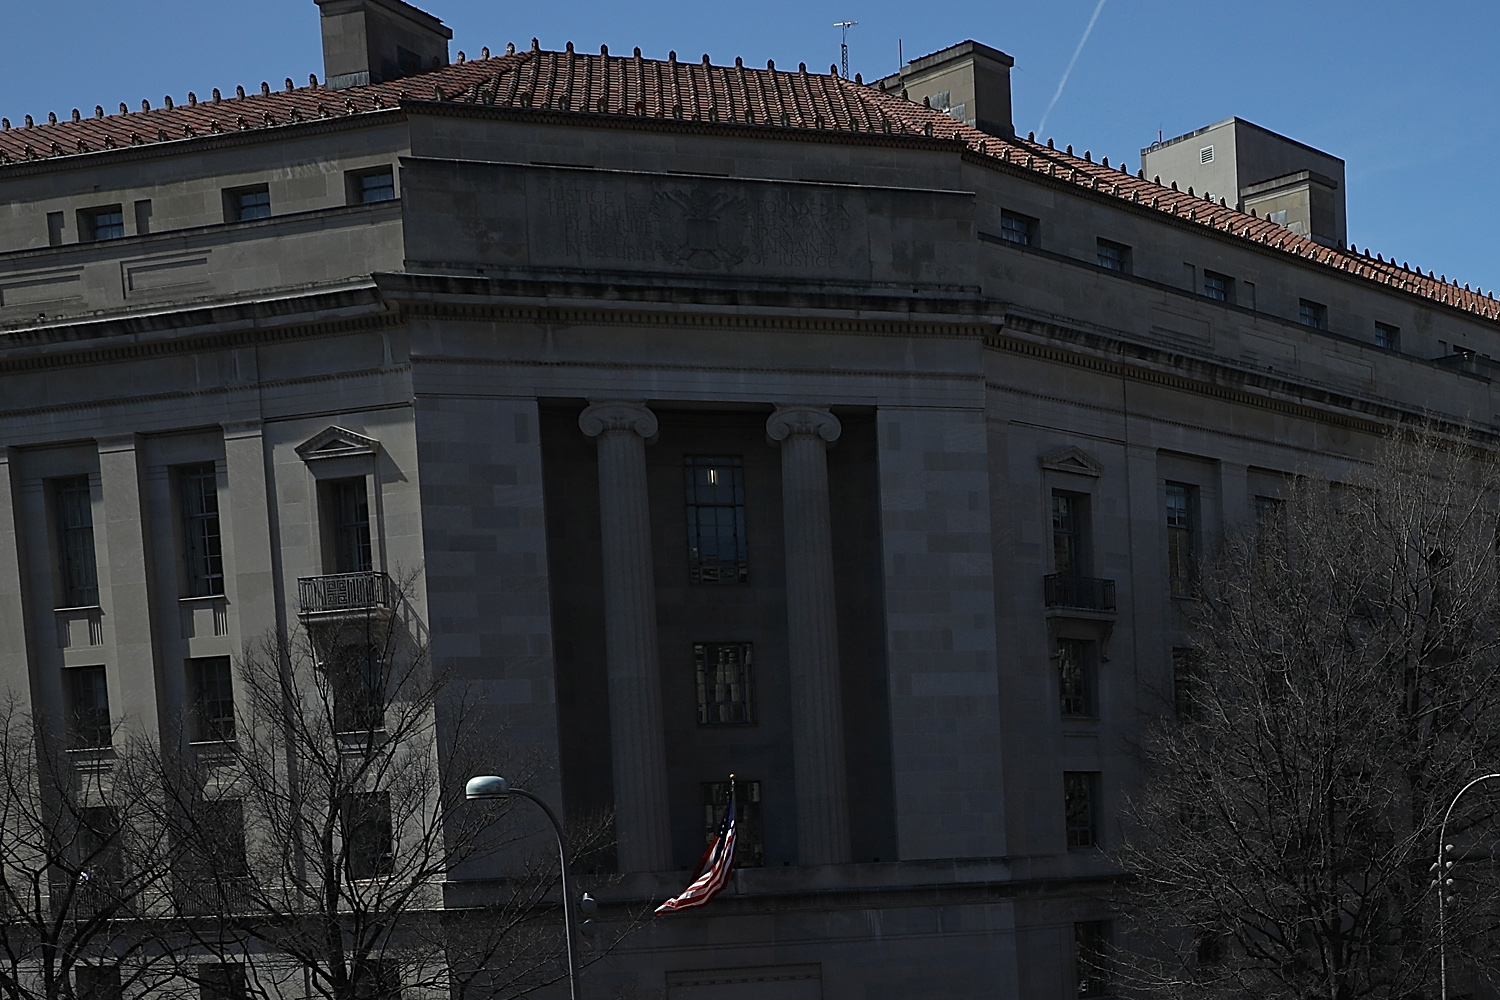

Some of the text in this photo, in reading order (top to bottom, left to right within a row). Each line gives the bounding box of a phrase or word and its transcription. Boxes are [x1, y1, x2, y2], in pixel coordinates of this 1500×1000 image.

[544, 187, 614, 205] JUSTICE
[547, 201, 647, 221] THE RIGHTS
[776, 255, 836, 269] JUSTICE
